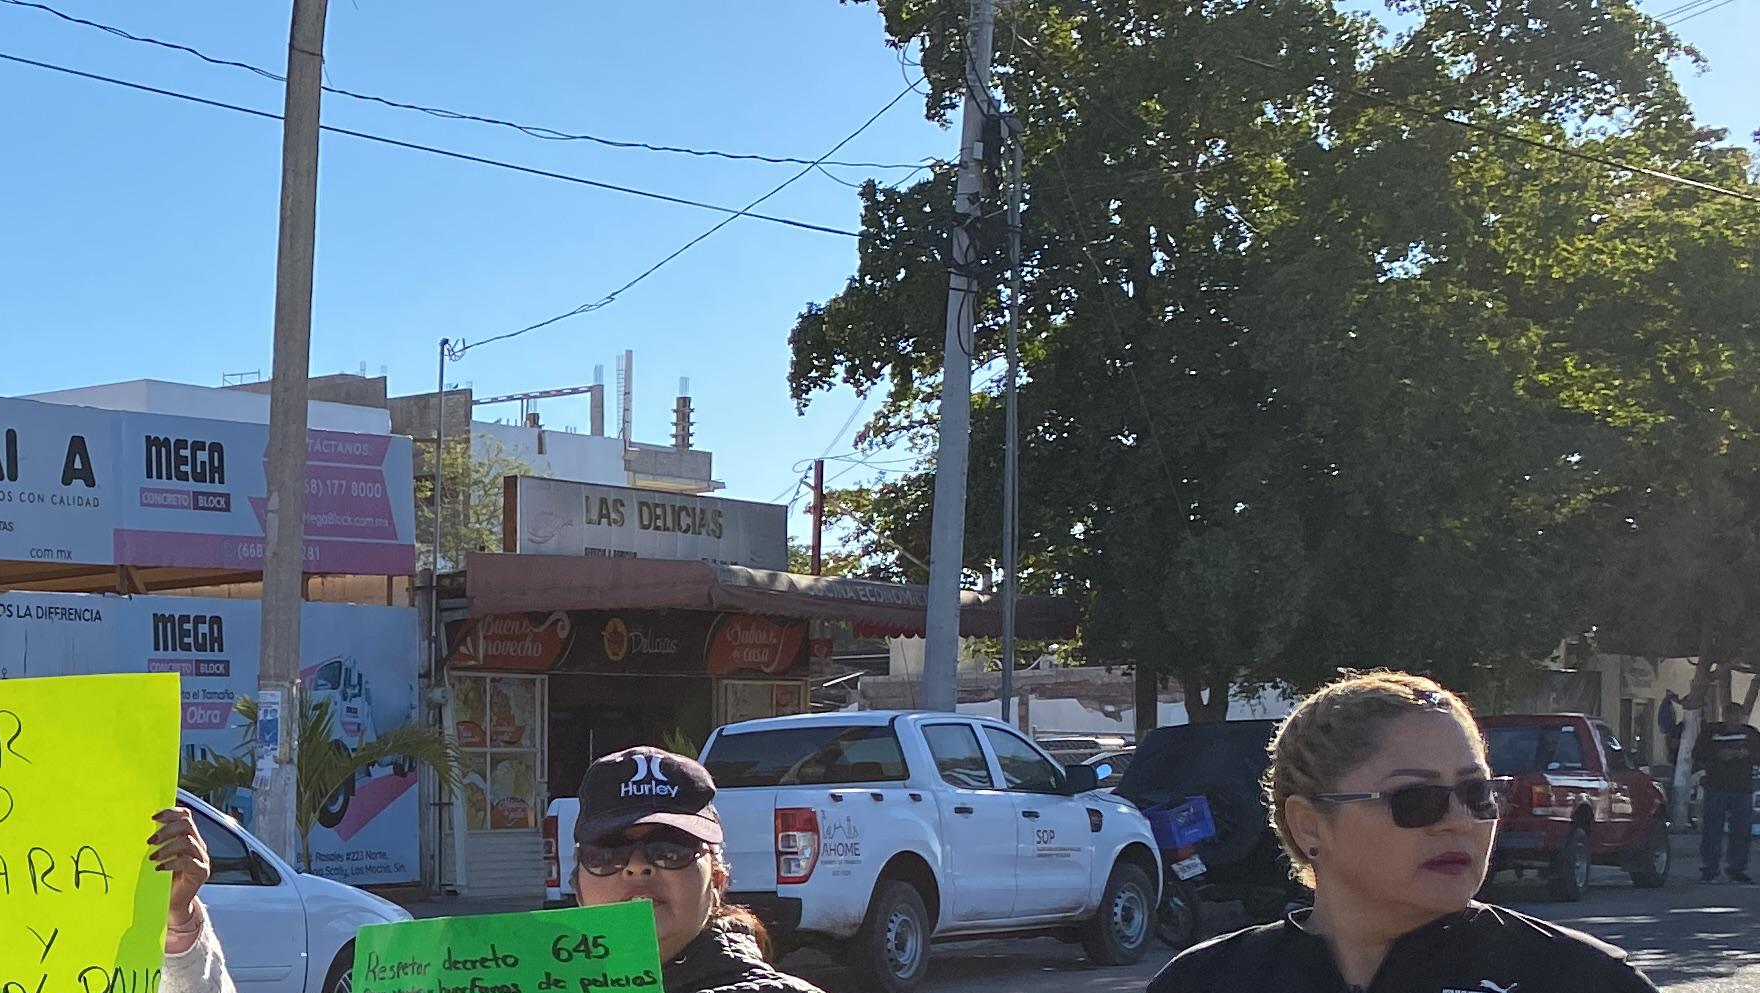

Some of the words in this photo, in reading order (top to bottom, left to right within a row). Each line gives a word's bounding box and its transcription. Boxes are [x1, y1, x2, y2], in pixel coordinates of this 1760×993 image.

[145, 435, 225, 485] MEGA
[327, 479, 346, 496] 177
[351, 481, 382, 498] 8000
[19, 491, 45, 504] CON
[51, 494, 100, 508] CALIDAD
[142, 492, 189, 507] CONCRETO
[198, 495, 227, 509] BLOCK
[584, 496, 626, 527] LAS
[639, 501, 723, 539] DELICIAS
[16, 605, 32, 619] LA
[36, 606, 102, 622] DIFERENCIA
[152, 613, 224, 652] MEGA
[199, 663, 225, 673] BLOCK
[192, 690, 200, 700] el
[201, 689, 234, 700] Tamaño
[186, 707, 220, 723] Obra
[620, 780, 679, 798] Hurley
[1036, 829, 1056, 845] SOP
[821, 842, 861, 857] AHOME
[26, 926, 59, 965] Y
[365, 951, 431, 982] Respetar
[442, 944, 520, 973] decreto
[551, 933, 611, 964] 645
[537, 972, 568, 992] de
